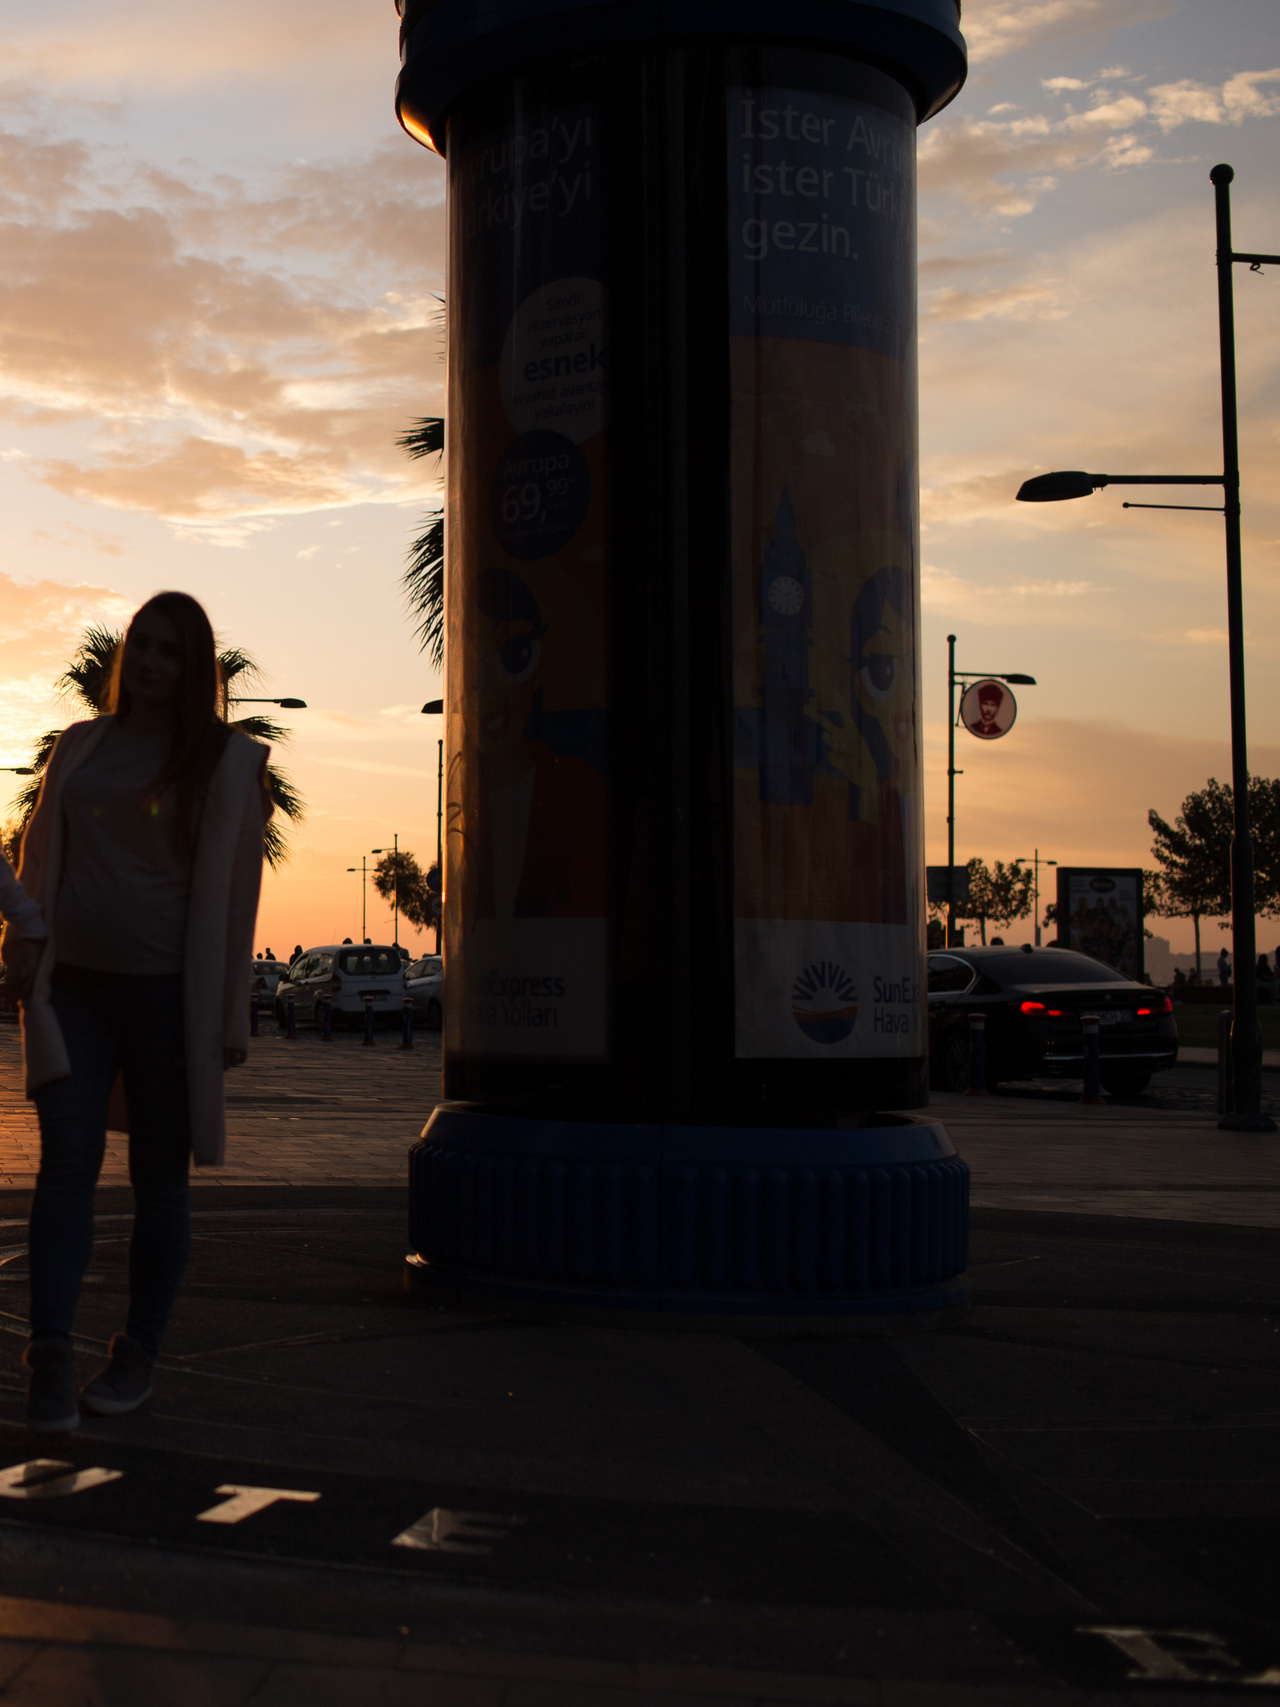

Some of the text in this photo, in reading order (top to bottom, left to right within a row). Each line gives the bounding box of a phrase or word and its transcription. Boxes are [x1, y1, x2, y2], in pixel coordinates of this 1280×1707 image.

[740, 89, 905, 176] İster Avru
[742, 152, 903, 224] ister Türk
[740, 212, 859, 261] gezin.
[546, 291, 581, 314] Şimdi
[742, 294, 838, 325] Mutluluğa
[527, 309, 602, 332] rezervasyon
[538, 328, 588, 351] yaparak
[524, 342, 607, 383] esnek
[502, 454, 570, 480] Avrupa
[872, 975, 921, 1004] SunEx
[500, 999, 558, 1028] Yolları
[873, 1006, 909, 1034] Hava
